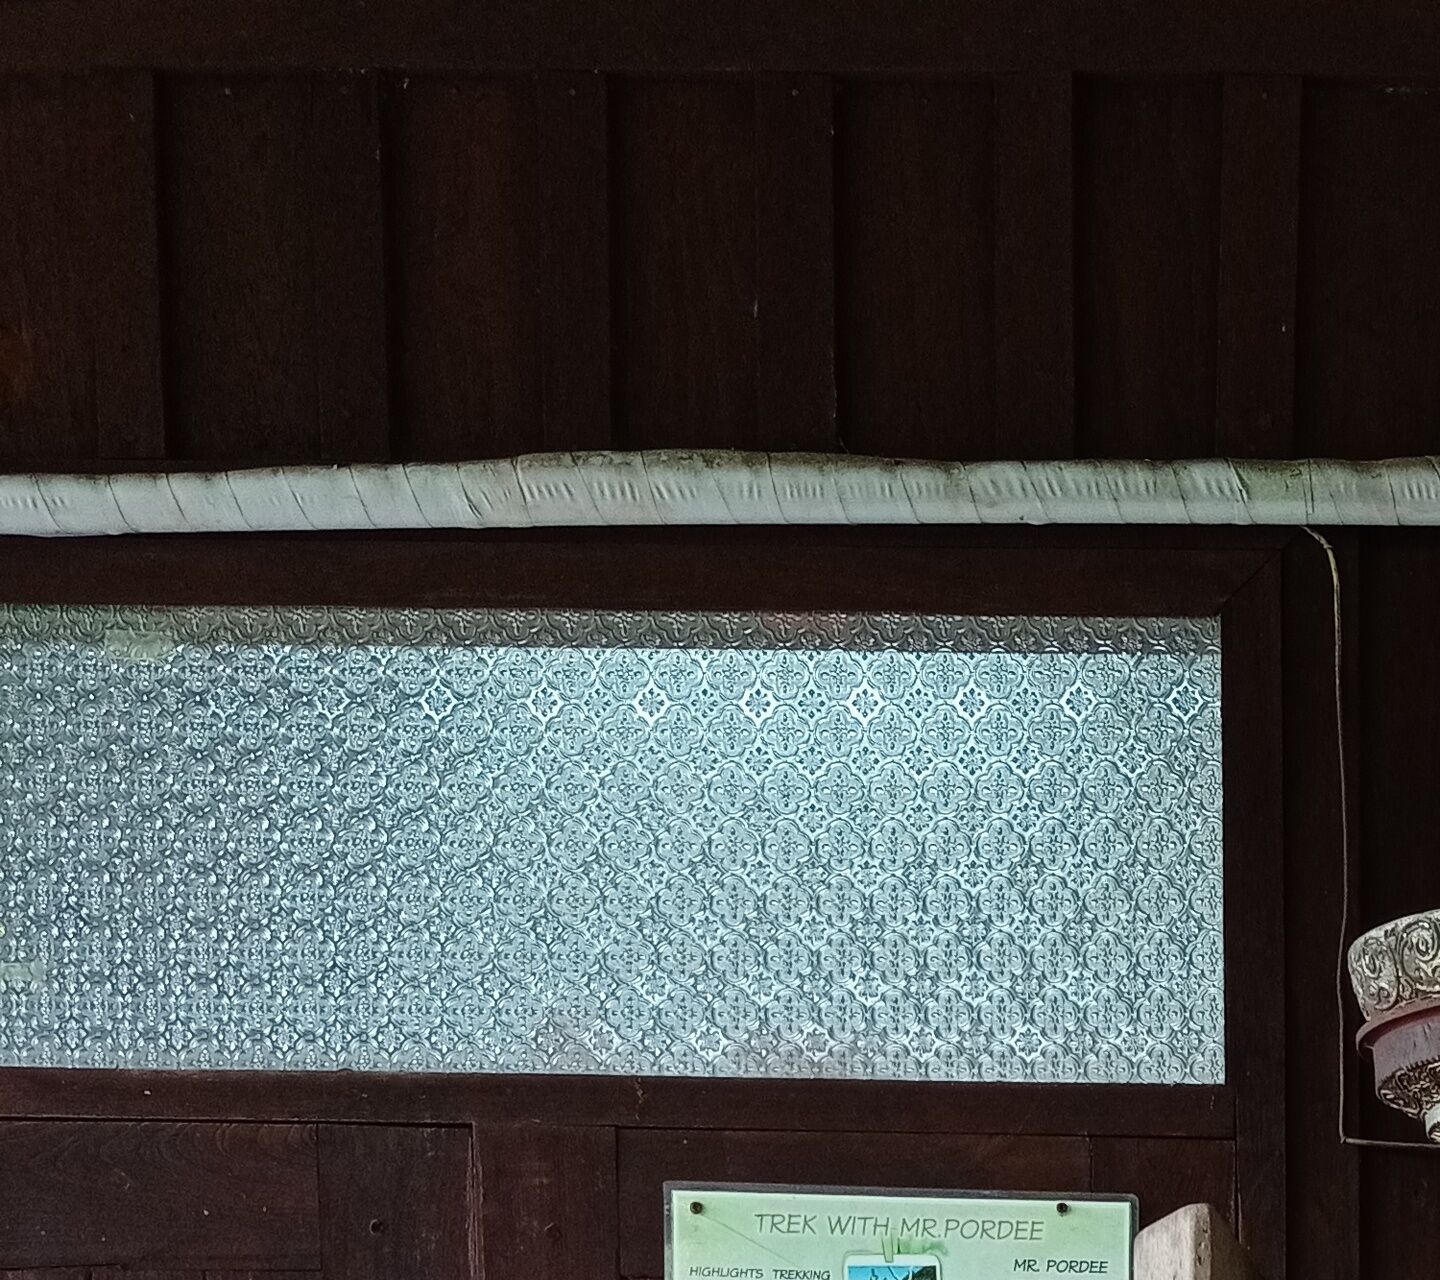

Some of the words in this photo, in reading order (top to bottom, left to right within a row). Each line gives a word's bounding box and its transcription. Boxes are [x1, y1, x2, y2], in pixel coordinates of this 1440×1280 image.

[755, 1214, 817, 1235] TREK
[827, 1216, 889, 1236] WITH
[900, 1218, 1044, 1240] MR.PORDEE
[1046, 1260, 1108, 1273] PORDEE
[773, 1269, 831, 1280] TREKKING
